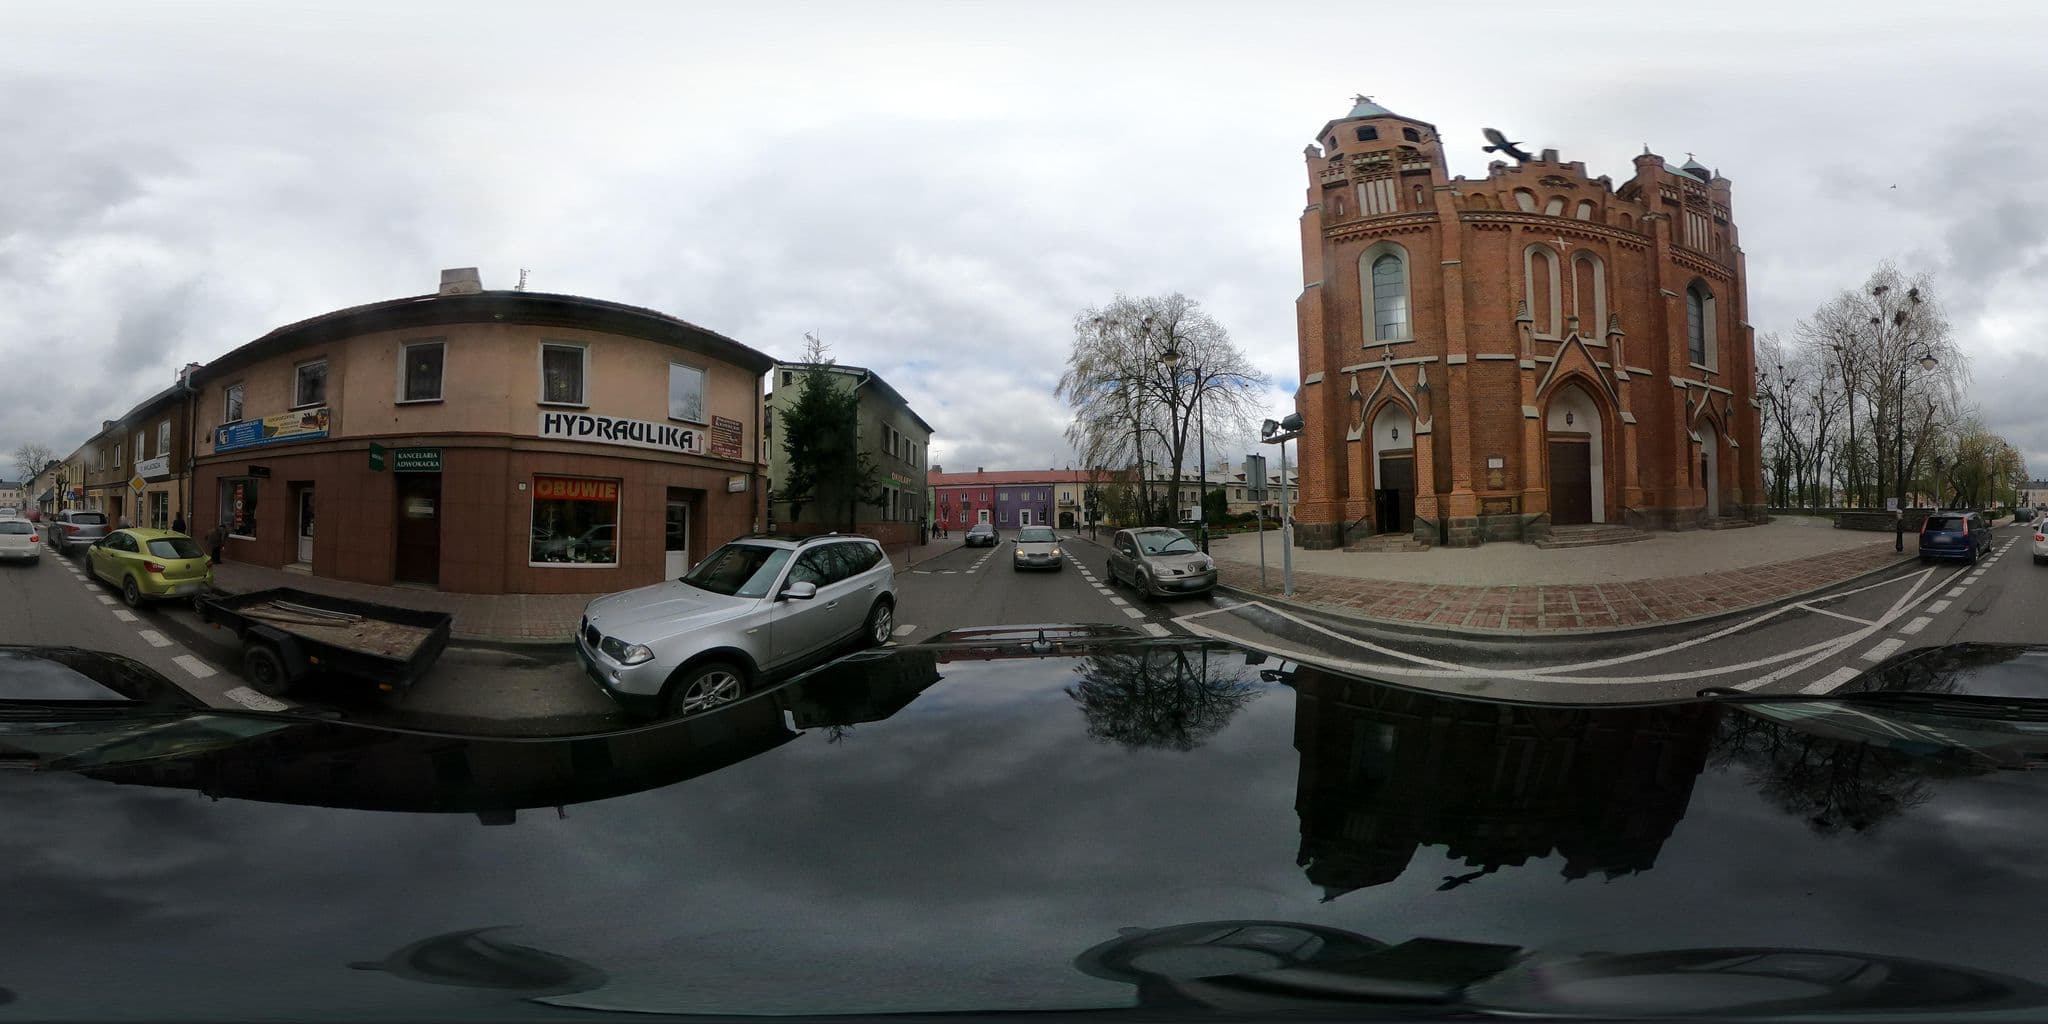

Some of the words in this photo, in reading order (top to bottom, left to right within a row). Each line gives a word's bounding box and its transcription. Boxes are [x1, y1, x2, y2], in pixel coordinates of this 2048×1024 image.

[544, 413, 693, 450] HYDRAULIKA
[396, 460, 440, 468] ADWOKACKA
[537, 479, 617, 498] OBUWIE
